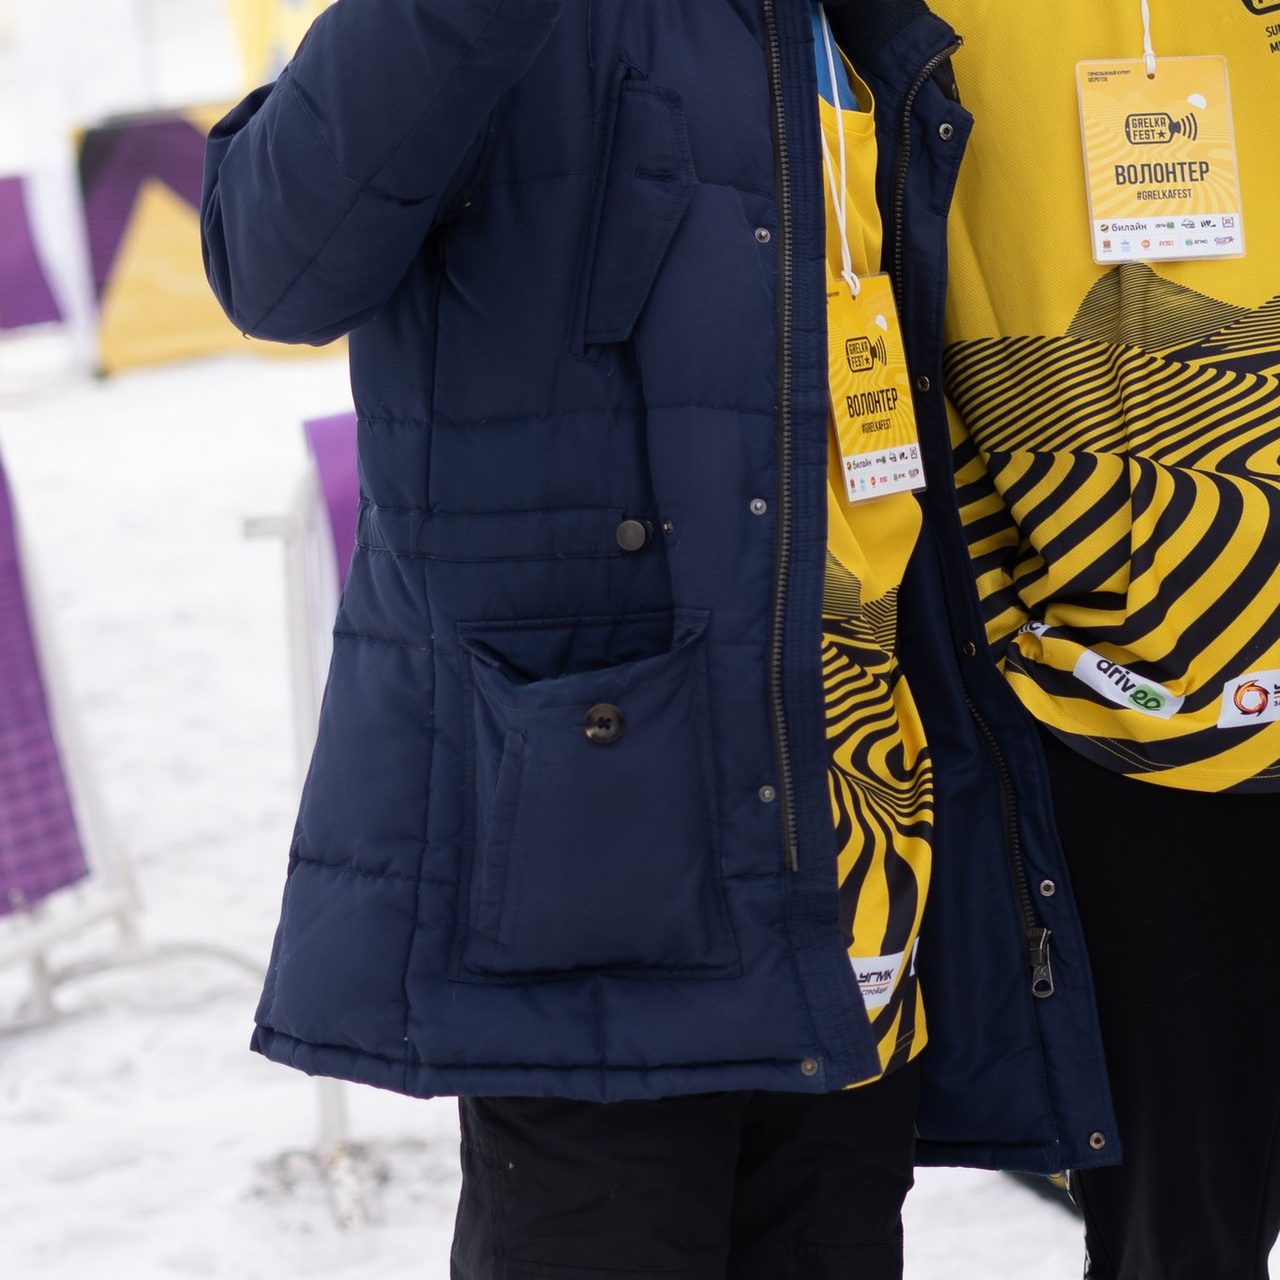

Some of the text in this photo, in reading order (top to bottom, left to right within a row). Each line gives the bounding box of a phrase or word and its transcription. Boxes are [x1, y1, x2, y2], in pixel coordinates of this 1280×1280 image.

[1131, 117, 1167, 129] GRELKA
[1132, 129, 1157, 141] FEST
[1114, 161, 1210, 186] ВОЛОНТЕР
[1136, 188, 1192, 201] #GRELKAFEST
[1111, 222, 1147, 232] билайн
[850, 354, 866, 368] FEST
[846, 387, 898, 419] ВОЛОНТЕР
